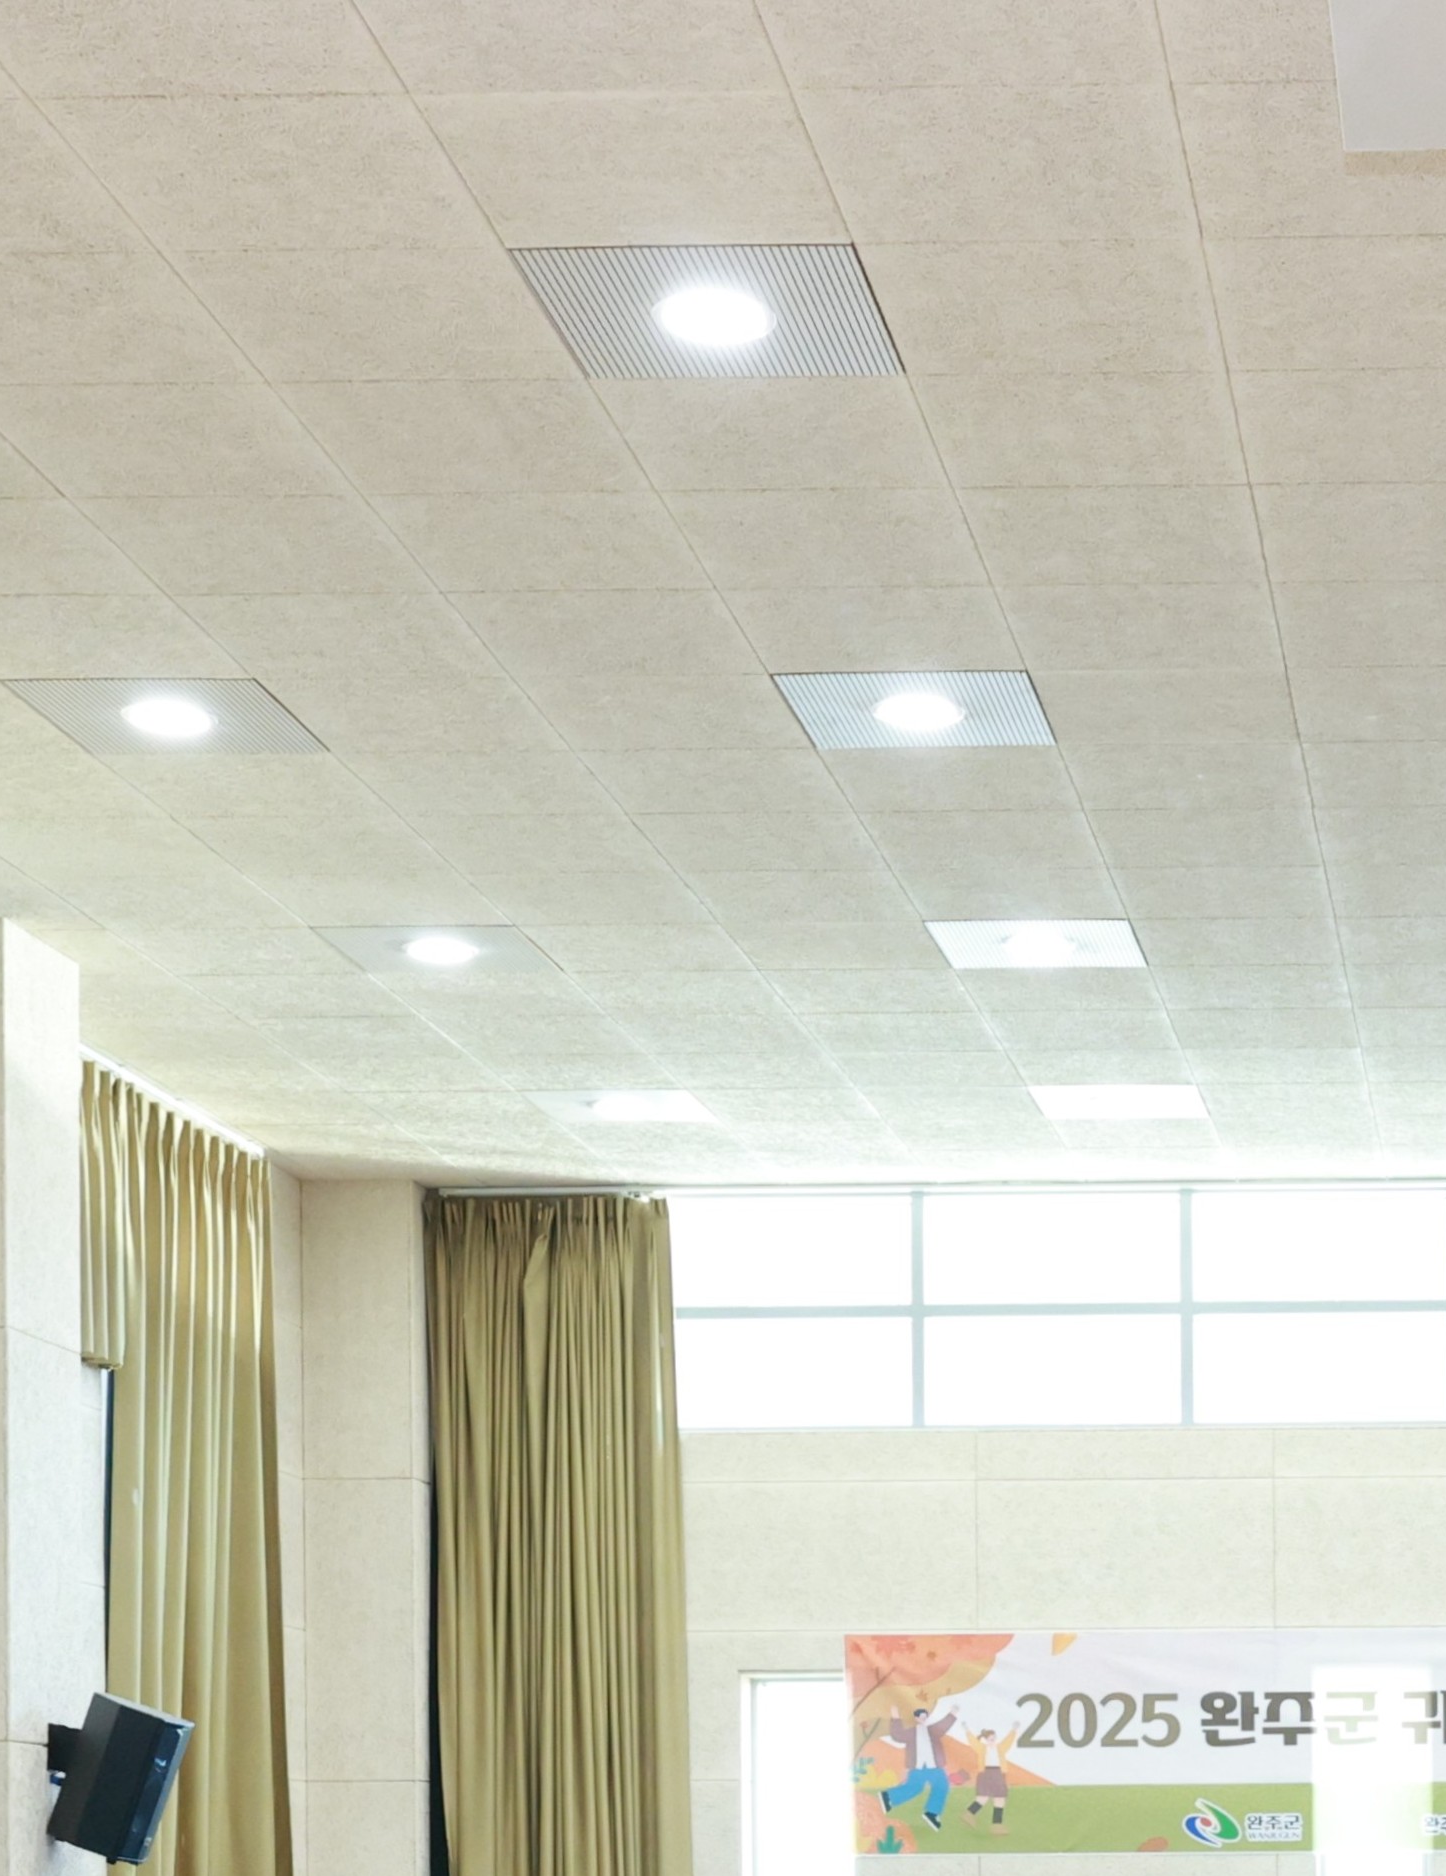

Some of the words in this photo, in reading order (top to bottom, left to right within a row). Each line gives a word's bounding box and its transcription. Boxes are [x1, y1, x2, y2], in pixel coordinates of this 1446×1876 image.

[1014, 1691, 1182, 1750] 2025
[1199, 1689, 1380, 1747] 완주군
[1246, 1813, 1302, 1831] 완주군
